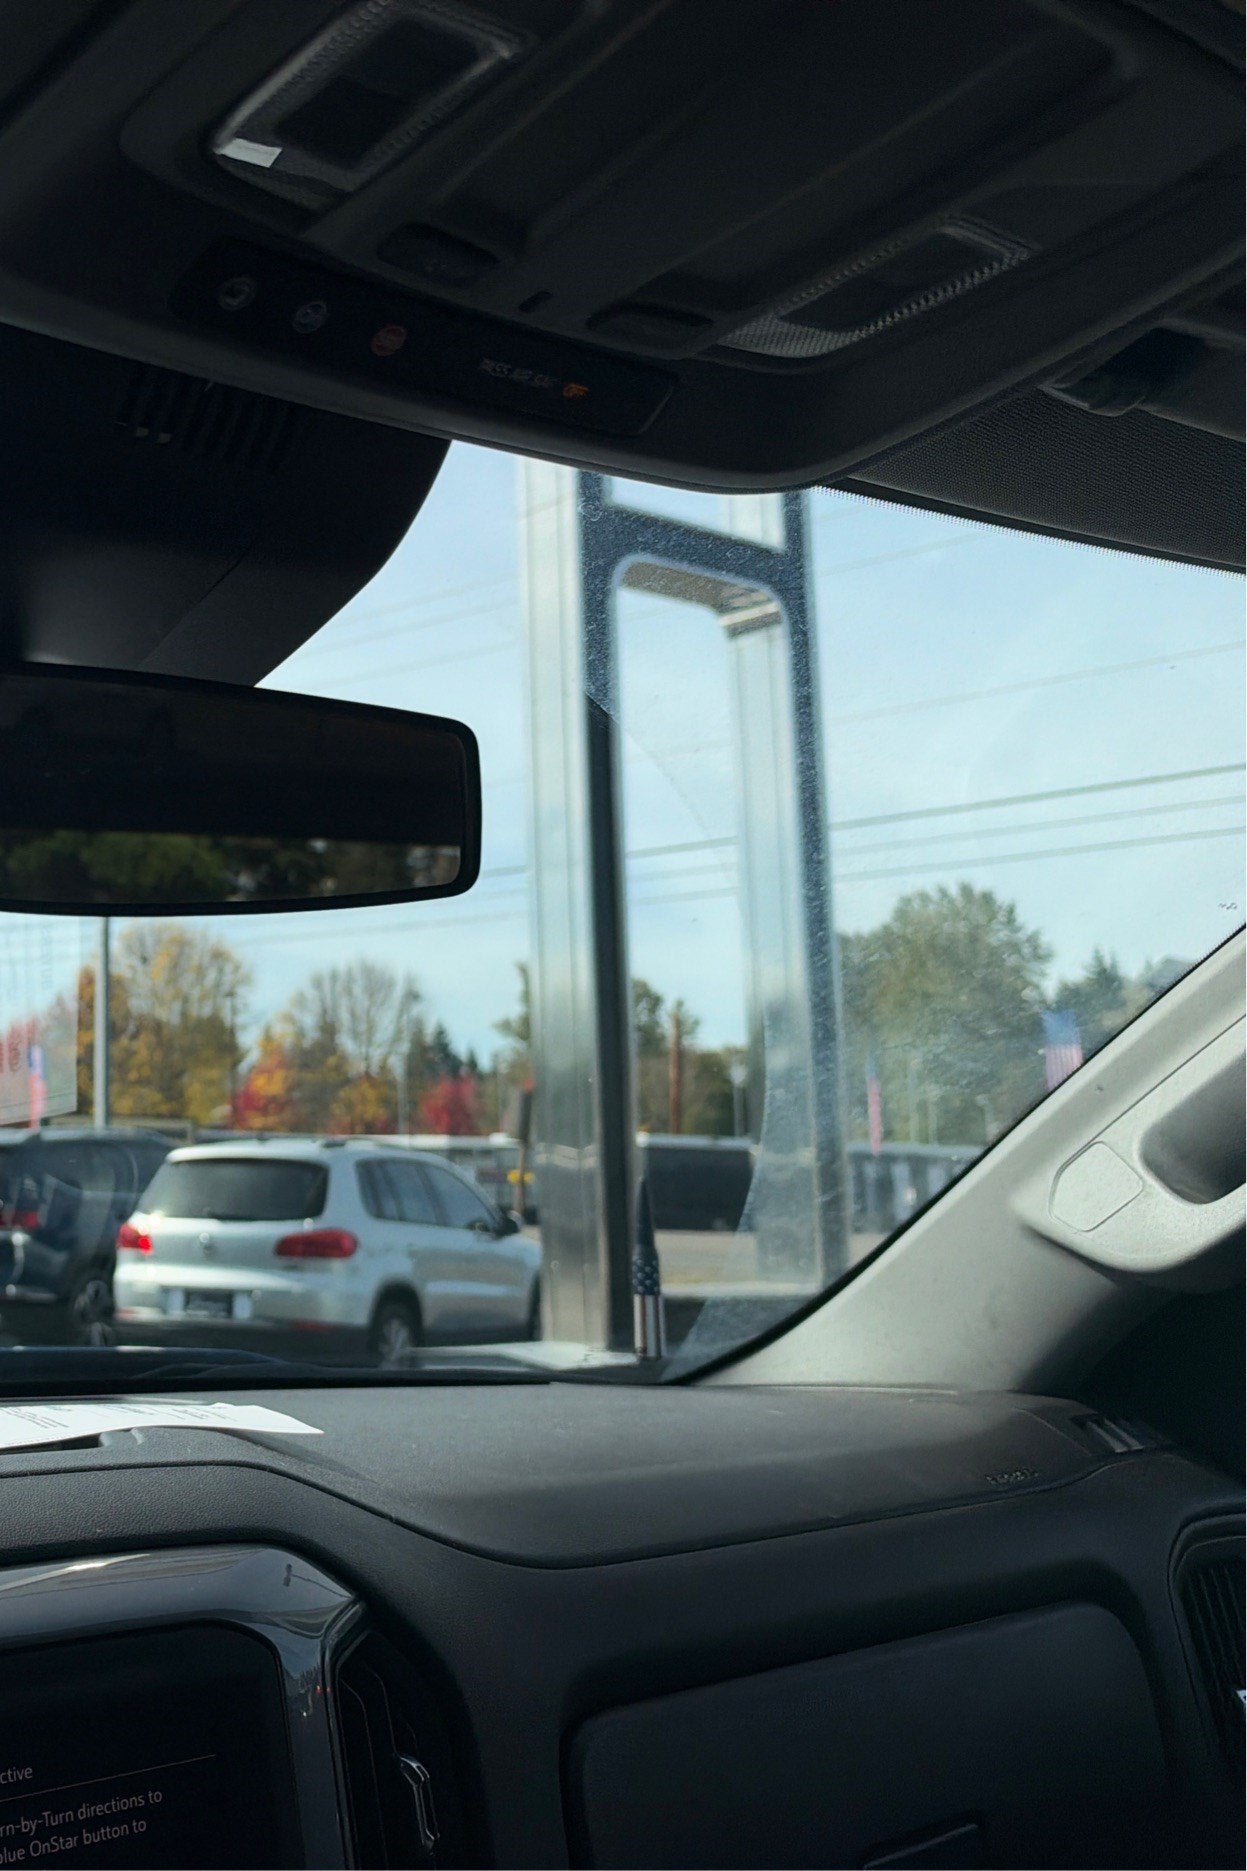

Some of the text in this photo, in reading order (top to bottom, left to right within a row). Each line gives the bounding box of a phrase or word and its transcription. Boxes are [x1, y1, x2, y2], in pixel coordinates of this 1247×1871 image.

[78, 1793, 145, 1820] directions
[148, 1790, 163, 1804] to
[29, 1834, 79, 1858] OnStar
[83, 1825, 129, 1845] button
[132, 1818, 147, 1833] to
